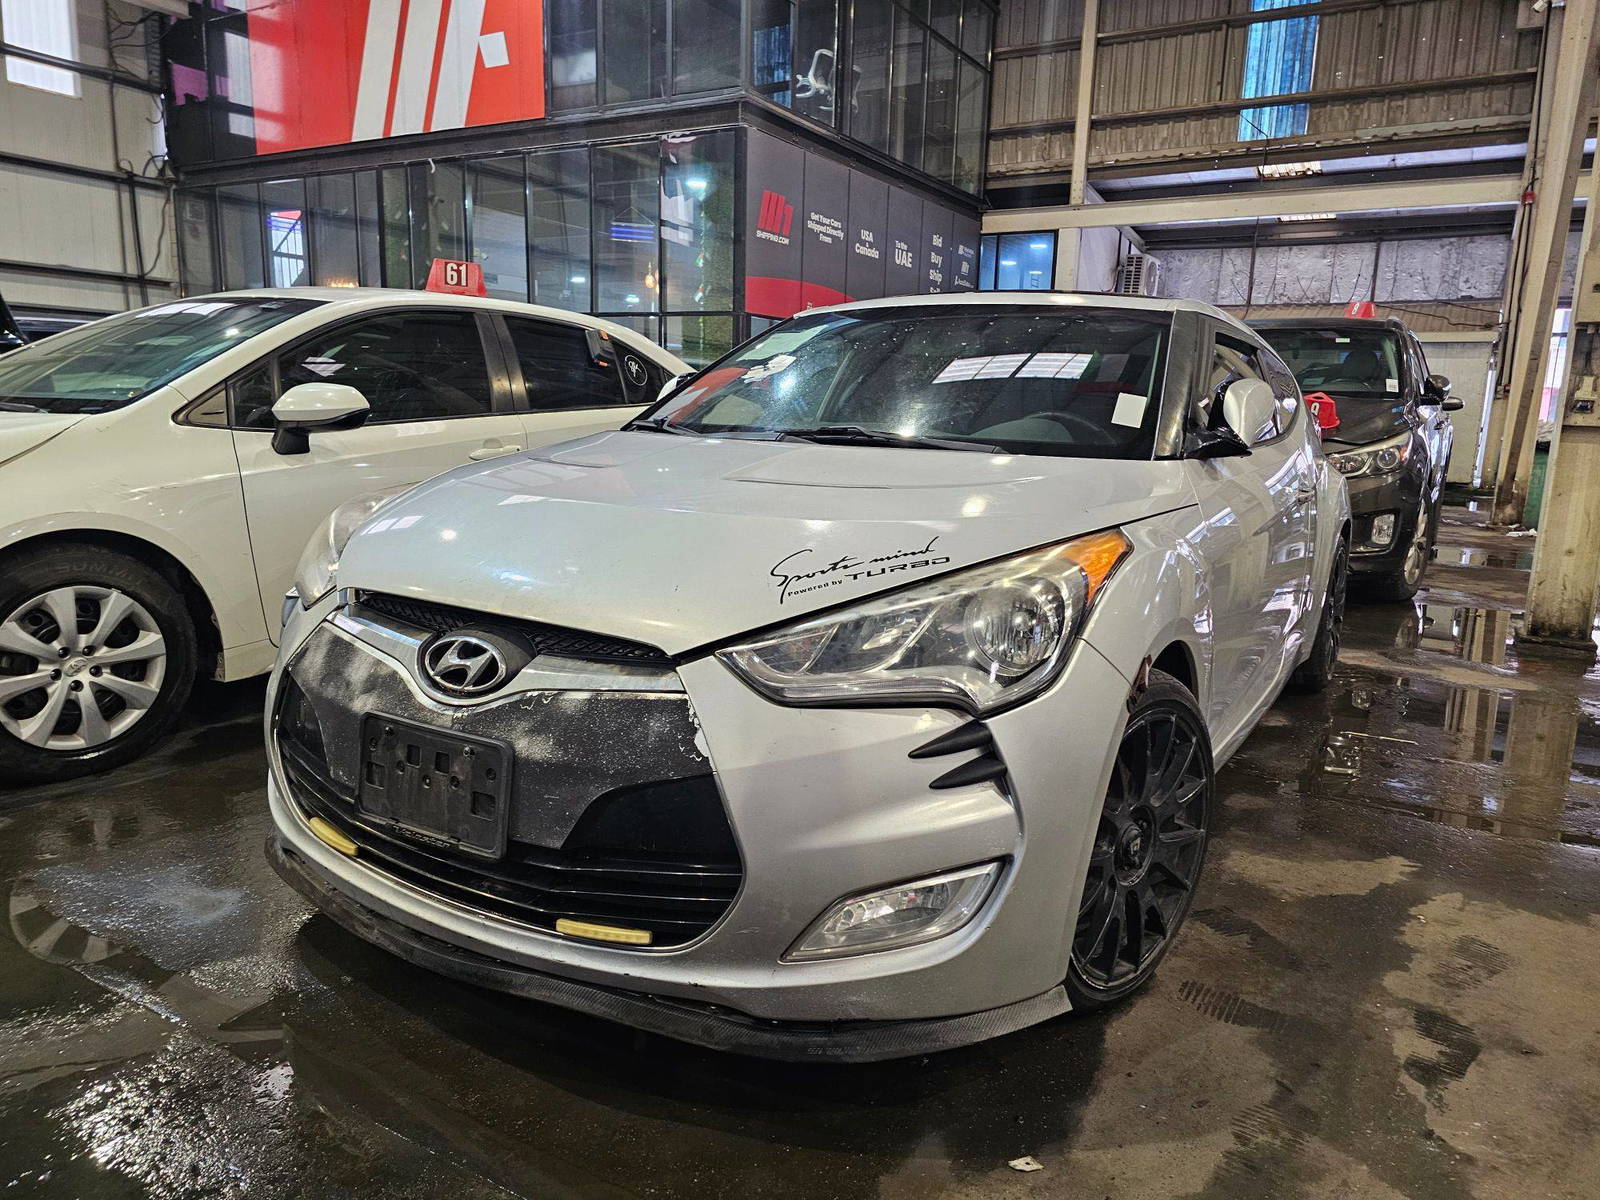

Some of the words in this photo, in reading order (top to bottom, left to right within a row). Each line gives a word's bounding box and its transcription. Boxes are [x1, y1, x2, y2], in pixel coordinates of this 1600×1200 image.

[810, 212, 820, 221] Get
[820, 214, 831, 225] Your
[830, 218, 842, 228] Cars
[807, 220, 827, 233] Shipped
[826, 226, 844, 241] Directly
[819, 233, 832, 244] From
[861, 229, 874, 243] USA
[932, 234, 943, 248] Bid
[855, 243, 880, 259] Canada
[895, 248, 913, 268] UAE
[930, 251, 943, 268] Buy
[446, 262, 468, 287] 61
[929, 269, 943, 285] Ship
[844, 556, 951, 581] TURBO
